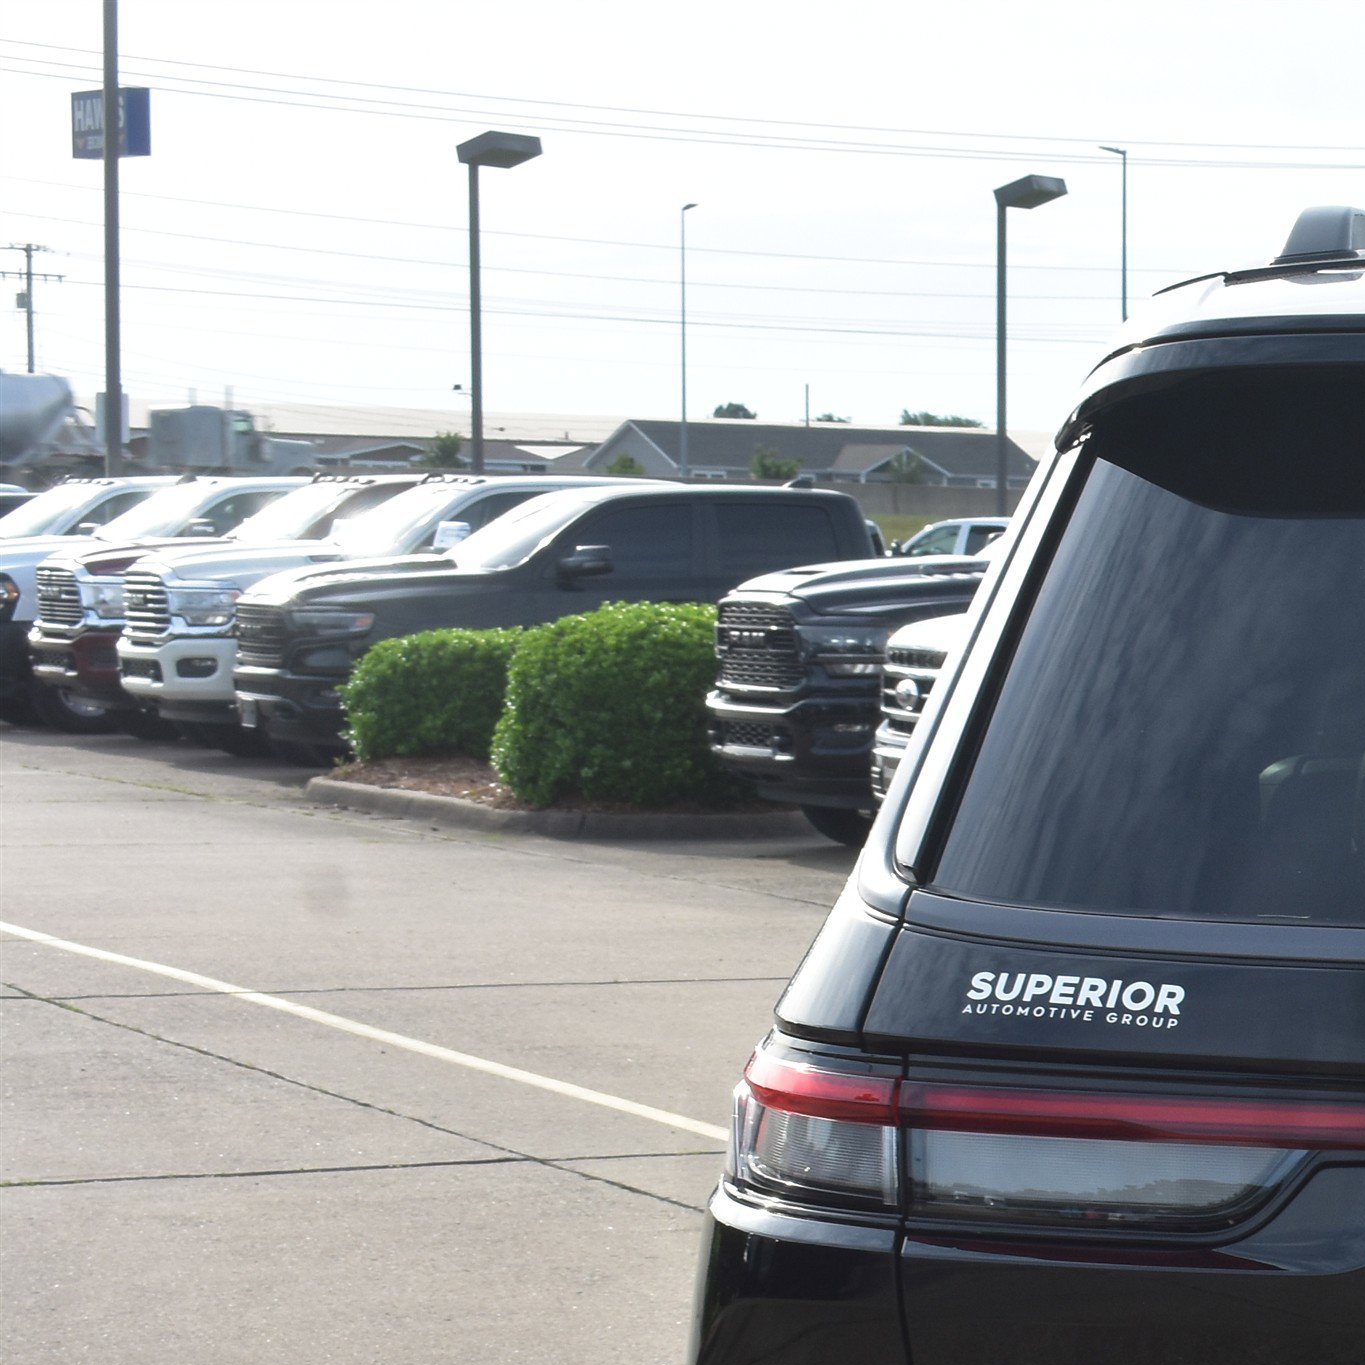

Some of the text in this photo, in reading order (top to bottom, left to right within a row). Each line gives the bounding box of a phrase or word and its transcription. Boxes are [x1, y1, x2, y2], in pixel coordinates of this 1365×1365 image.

[966, 971, 1186, 1015] SUPERIOR
[962, 1003, 1179, 1029] AUTOMOTIVE GROUP
